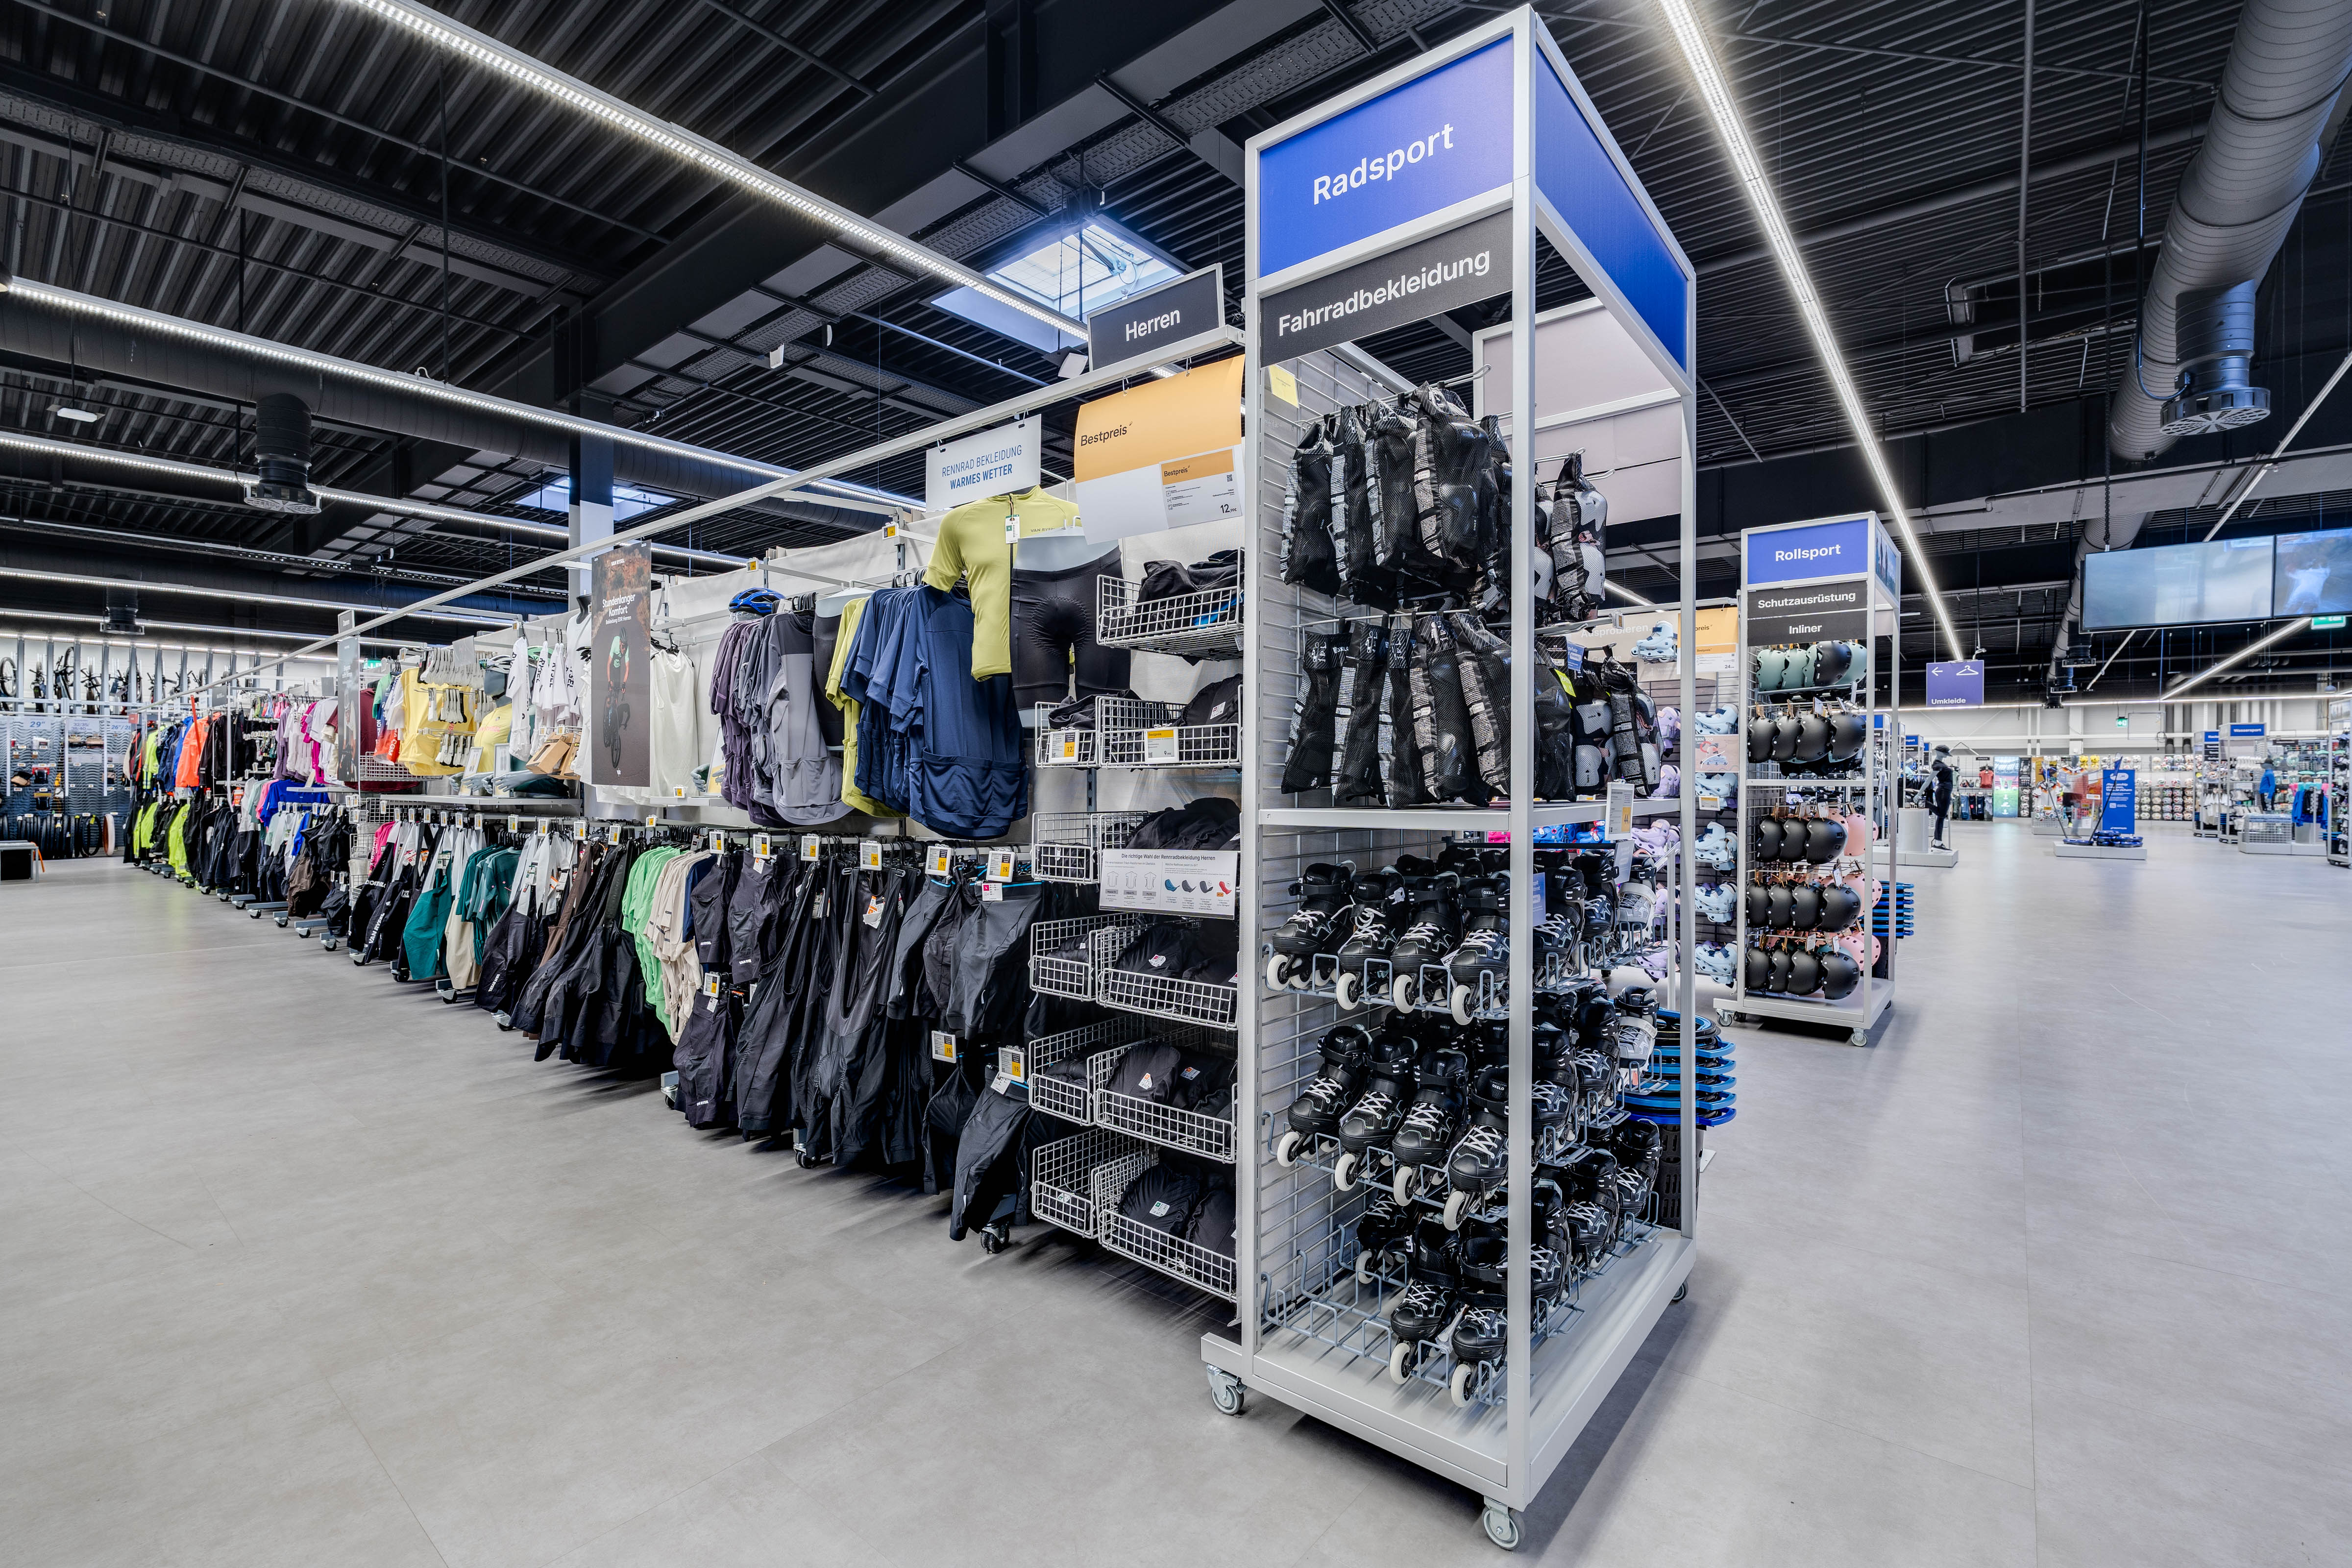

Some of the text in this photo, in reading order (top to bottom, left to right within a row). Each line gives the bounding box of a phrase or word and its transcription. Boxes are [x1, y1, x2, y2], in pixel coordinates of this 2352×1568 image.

[1313, 122, 1454, 206] Radsport
[1277, 249, 1491, 337] Fahrradbekleidung
[1125, 309, 1180, 342] Herren
[1080, 423, 1127, 446] Bestpreis
[942, 444, 1022, 478] RENNRAD BEKLEIDUNG
[950, 464, 1012, 490] WARMES WETTER
[1164, 467, 1188, 477] Bestpreis
[1220, 504, 1237, 514] 12,99€
[1775, 544, 1841, 562] Rollsport
[602, 594, 636, 608] Stundenlanger
[1758, 592, 1856, 609] Schutzausrüstung
[609, 605, 628, 617] Komfort
[1789, 624, 1822, 634] Inliner
[1931, 696, 1966, 705] Umkleide
